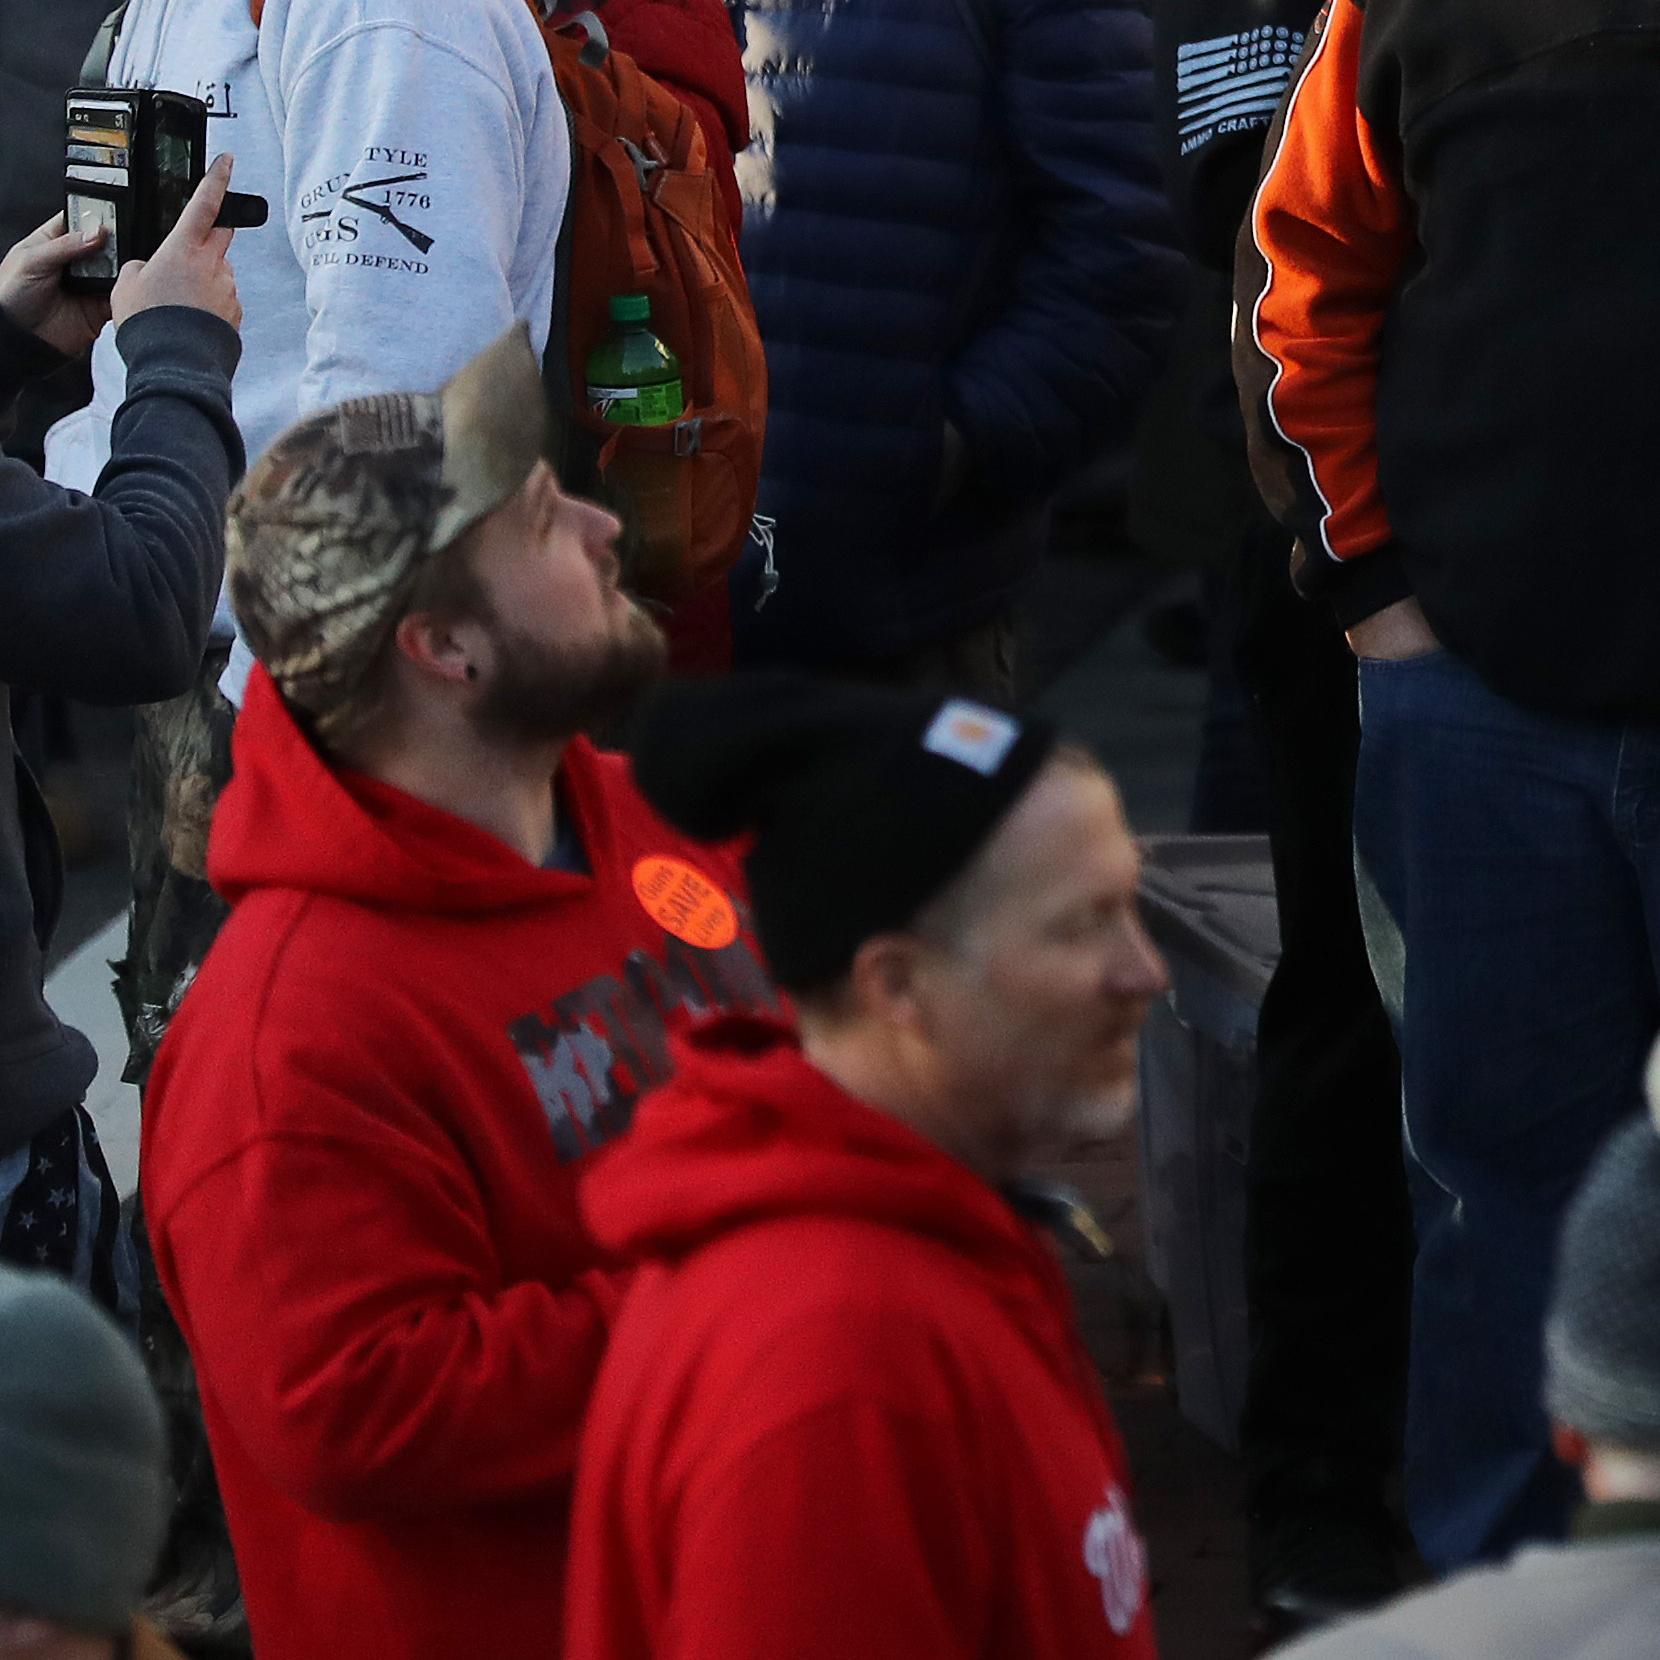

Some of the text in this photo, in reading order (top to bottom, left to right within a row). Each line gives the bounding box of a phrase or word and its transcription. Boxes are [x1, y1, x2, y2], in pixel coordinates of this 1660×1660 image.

[1180, 128, 1214, 157] AMMO
[383, 190, 432, 210] 1776
[345, 254, 430, 276] DEFEND
[658, 873, 712, 929] SAVE
